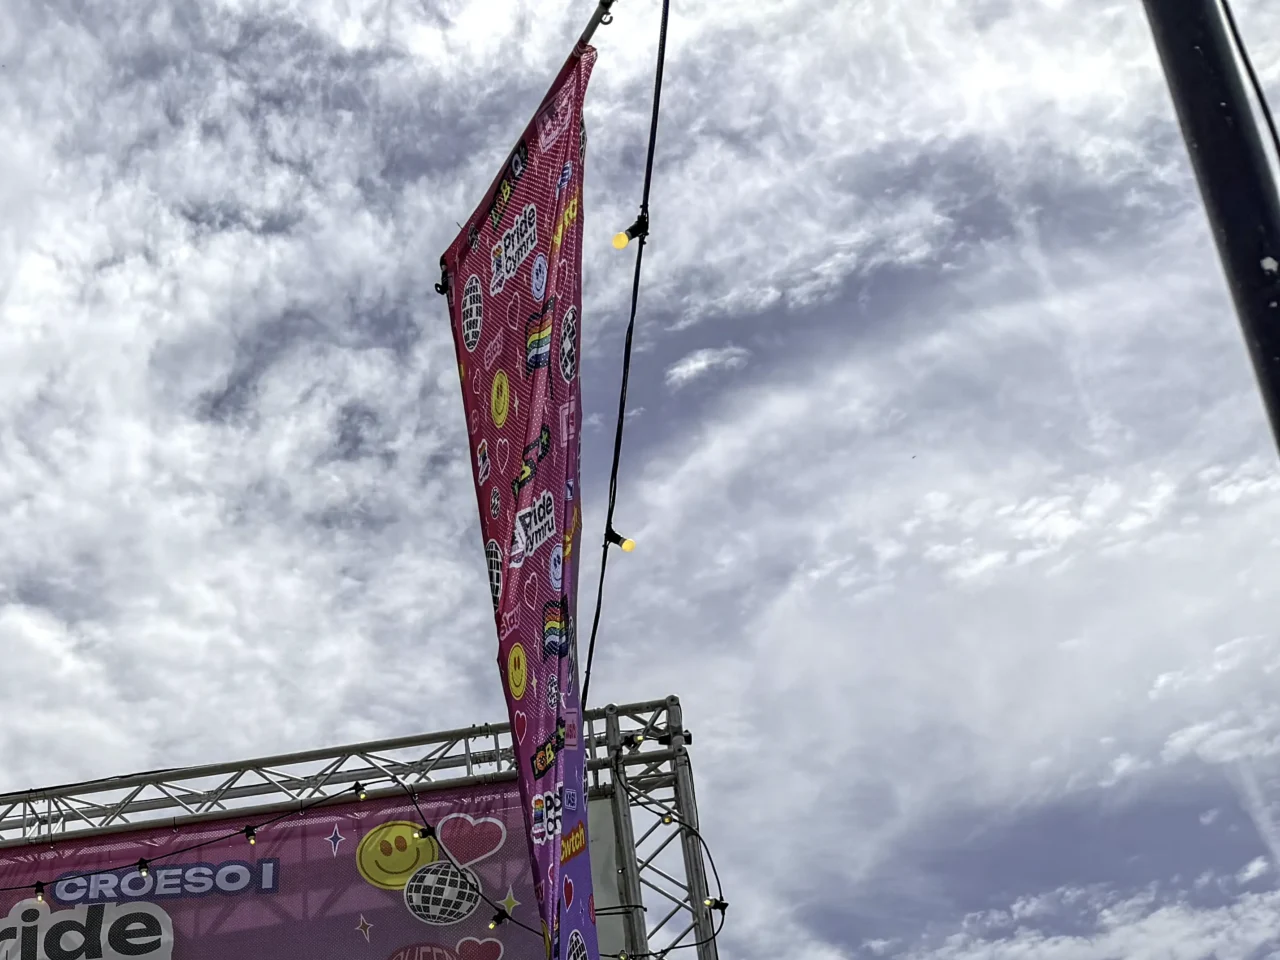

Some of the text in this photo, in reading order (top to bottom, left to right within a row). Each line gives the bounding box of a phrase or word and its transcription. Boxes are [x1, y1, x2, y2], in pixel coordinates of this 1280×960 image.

[503, 207, 536, 256] Pride
[505, 231, 537, 274] Cymru
[55, 862, 275, 900] CROESO I
